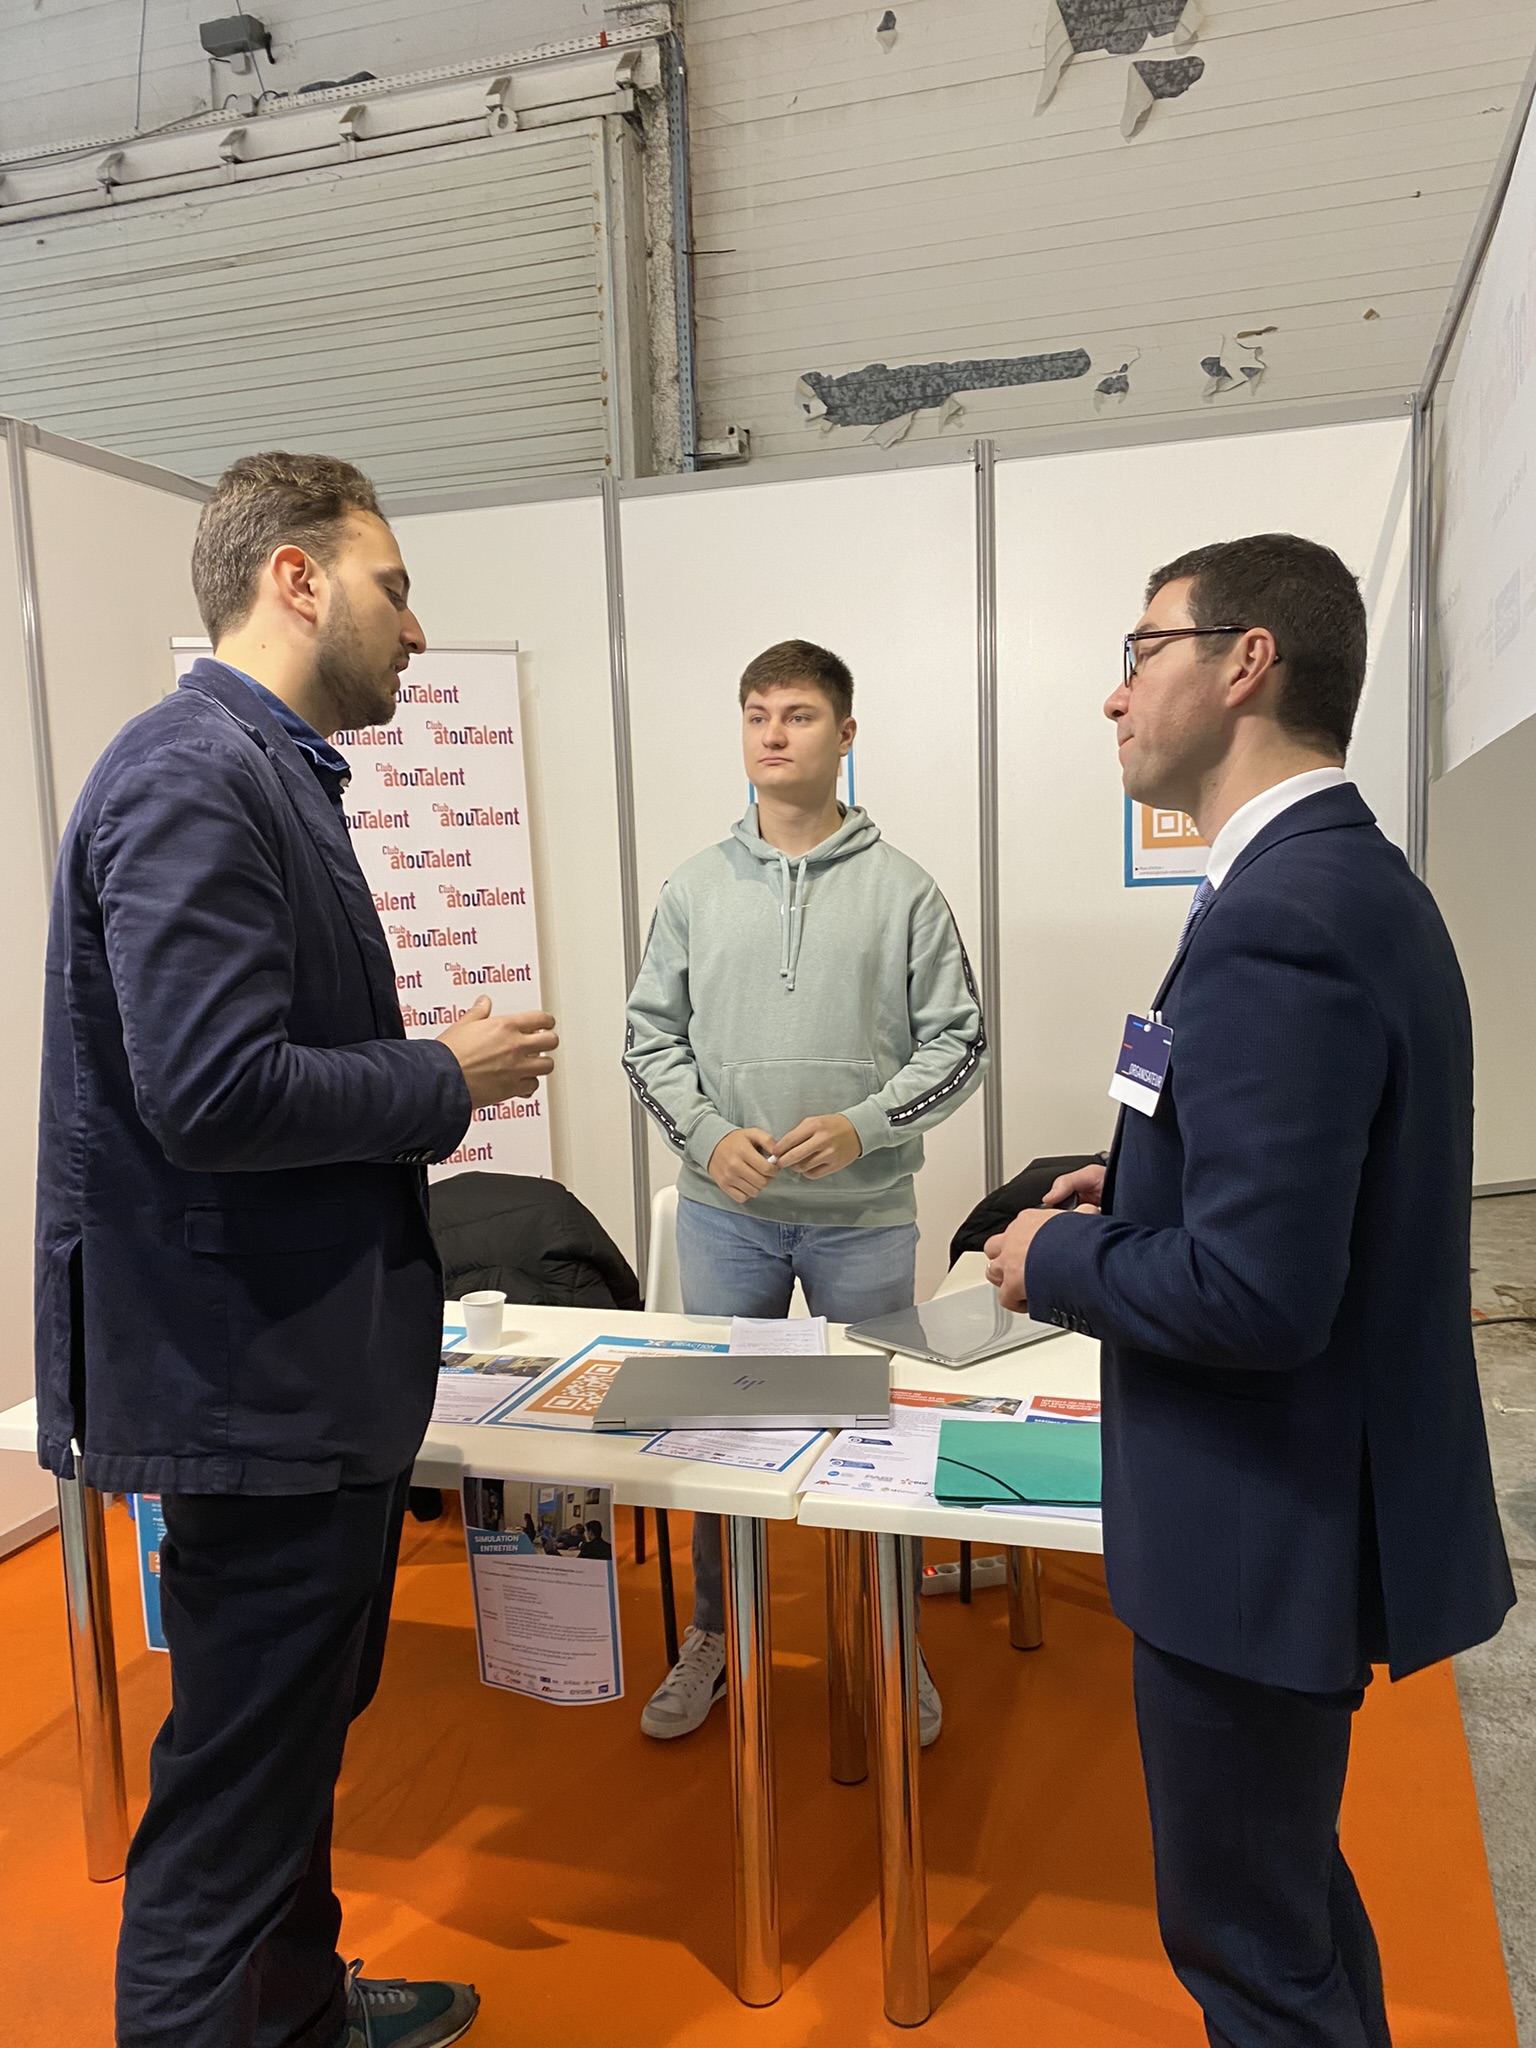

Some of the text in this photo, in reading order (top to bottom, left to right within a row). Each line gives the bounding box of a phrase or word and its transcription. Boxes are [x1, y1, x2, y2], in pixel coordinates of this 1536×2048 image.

[396, 683, 459, 703] ouTalent
[426, 720, 443, 730] Club
[328, 725, 403, 746] ouTalent
[434, 725, 514, 746] atouTalent
[376, 762, 393, 772] Club
[383, 766, 466, 787] atouTalent
[432, 803, 449, 813] Club
[440, 807, 520, 827] atouTalent
[345, 809, 410, 829] ouTalent
[382, 846, 399, 856] Club
[390, 849, 472, 870] atouTalent
[438, 884, 455, 894] Club
[446, 887, 526, 908] atouTalent
[388, 925, 405, 935] Club
[396, 927, 478, 949] atouTalent
[444, 962, 461, 972] Club
[452, 963, 532, 986] atouTalent
[403, 1004, 466, 1027] atouTale
[472, 1099, 541, 1122] touTalent
[474, 1534, 519, 1543] SIMULATION
[479, 1543, 518, 1552] ENTRETIEN
